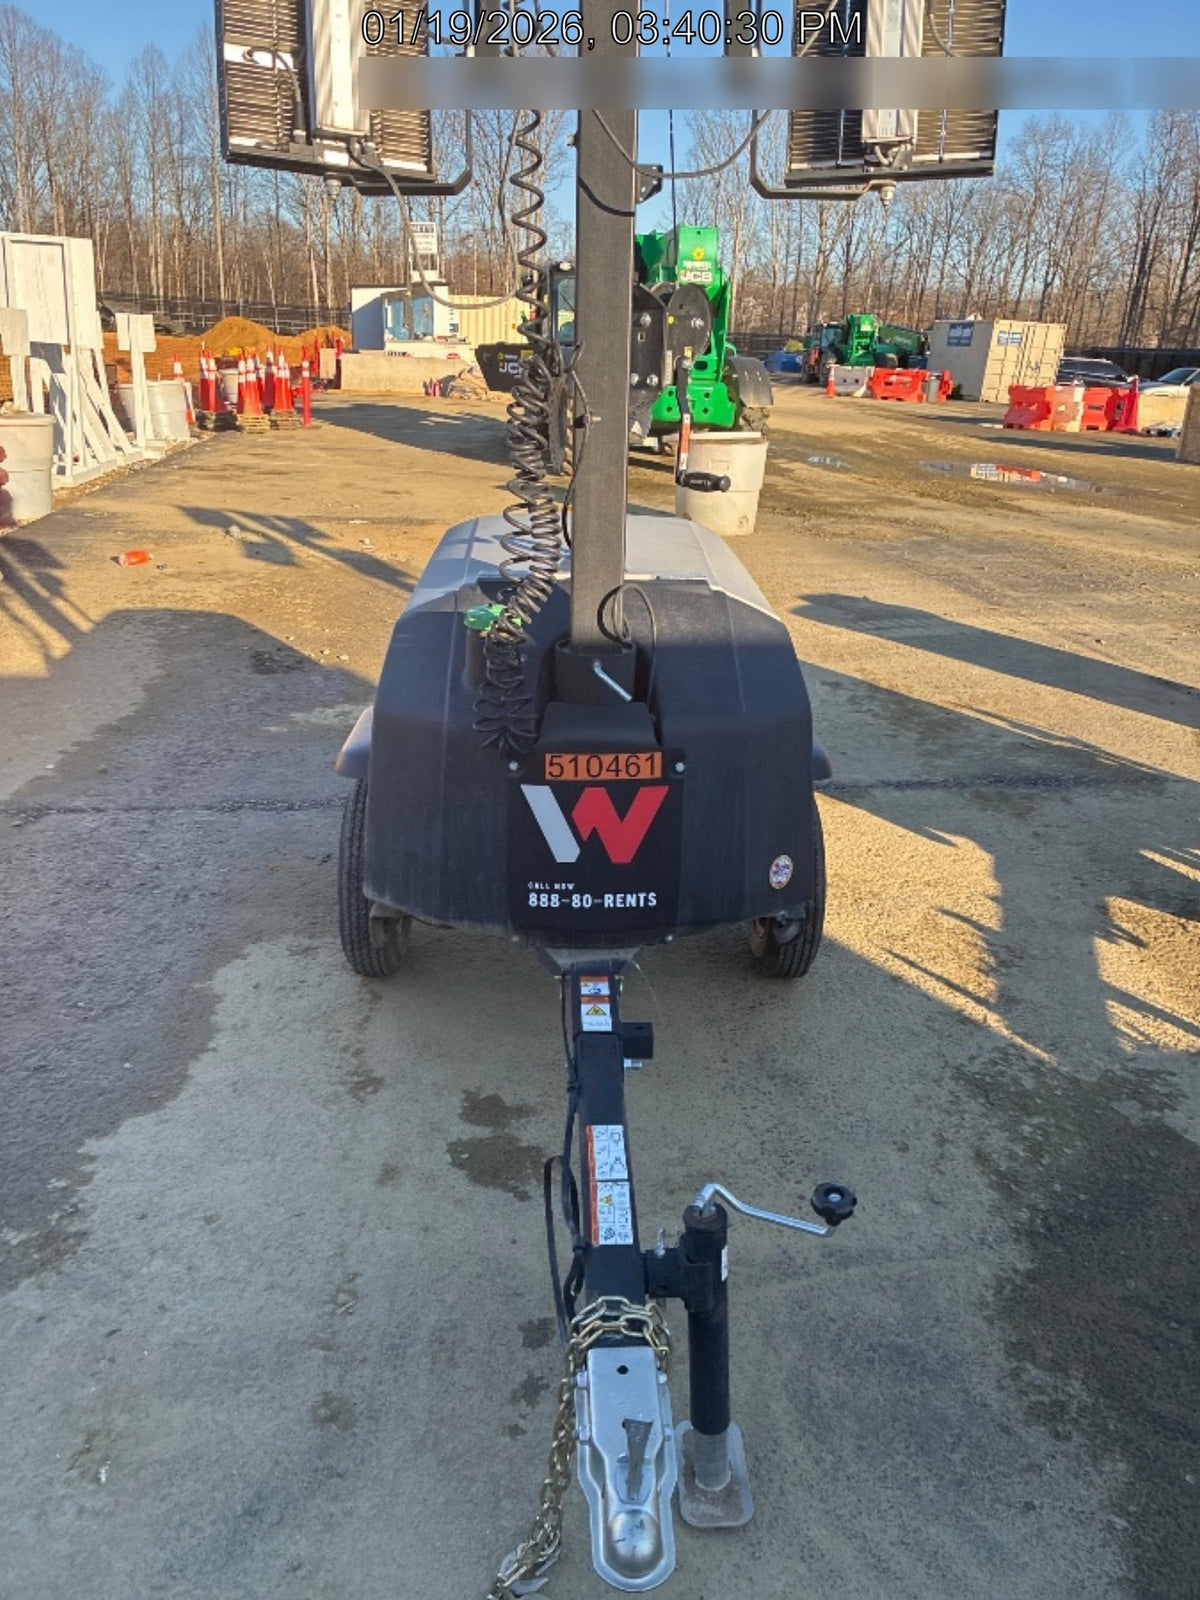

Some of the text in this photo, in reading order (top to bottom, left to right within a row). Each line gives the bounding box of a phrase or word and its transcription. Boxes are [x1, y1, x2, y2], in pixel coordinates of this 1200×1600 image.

[681, 270, 712, 282] JCB
[548, 754, 656, 778] 510461
[528, 881, 550, 890] CALL
[528, 892, 657, 908] 888-80-RENTS
